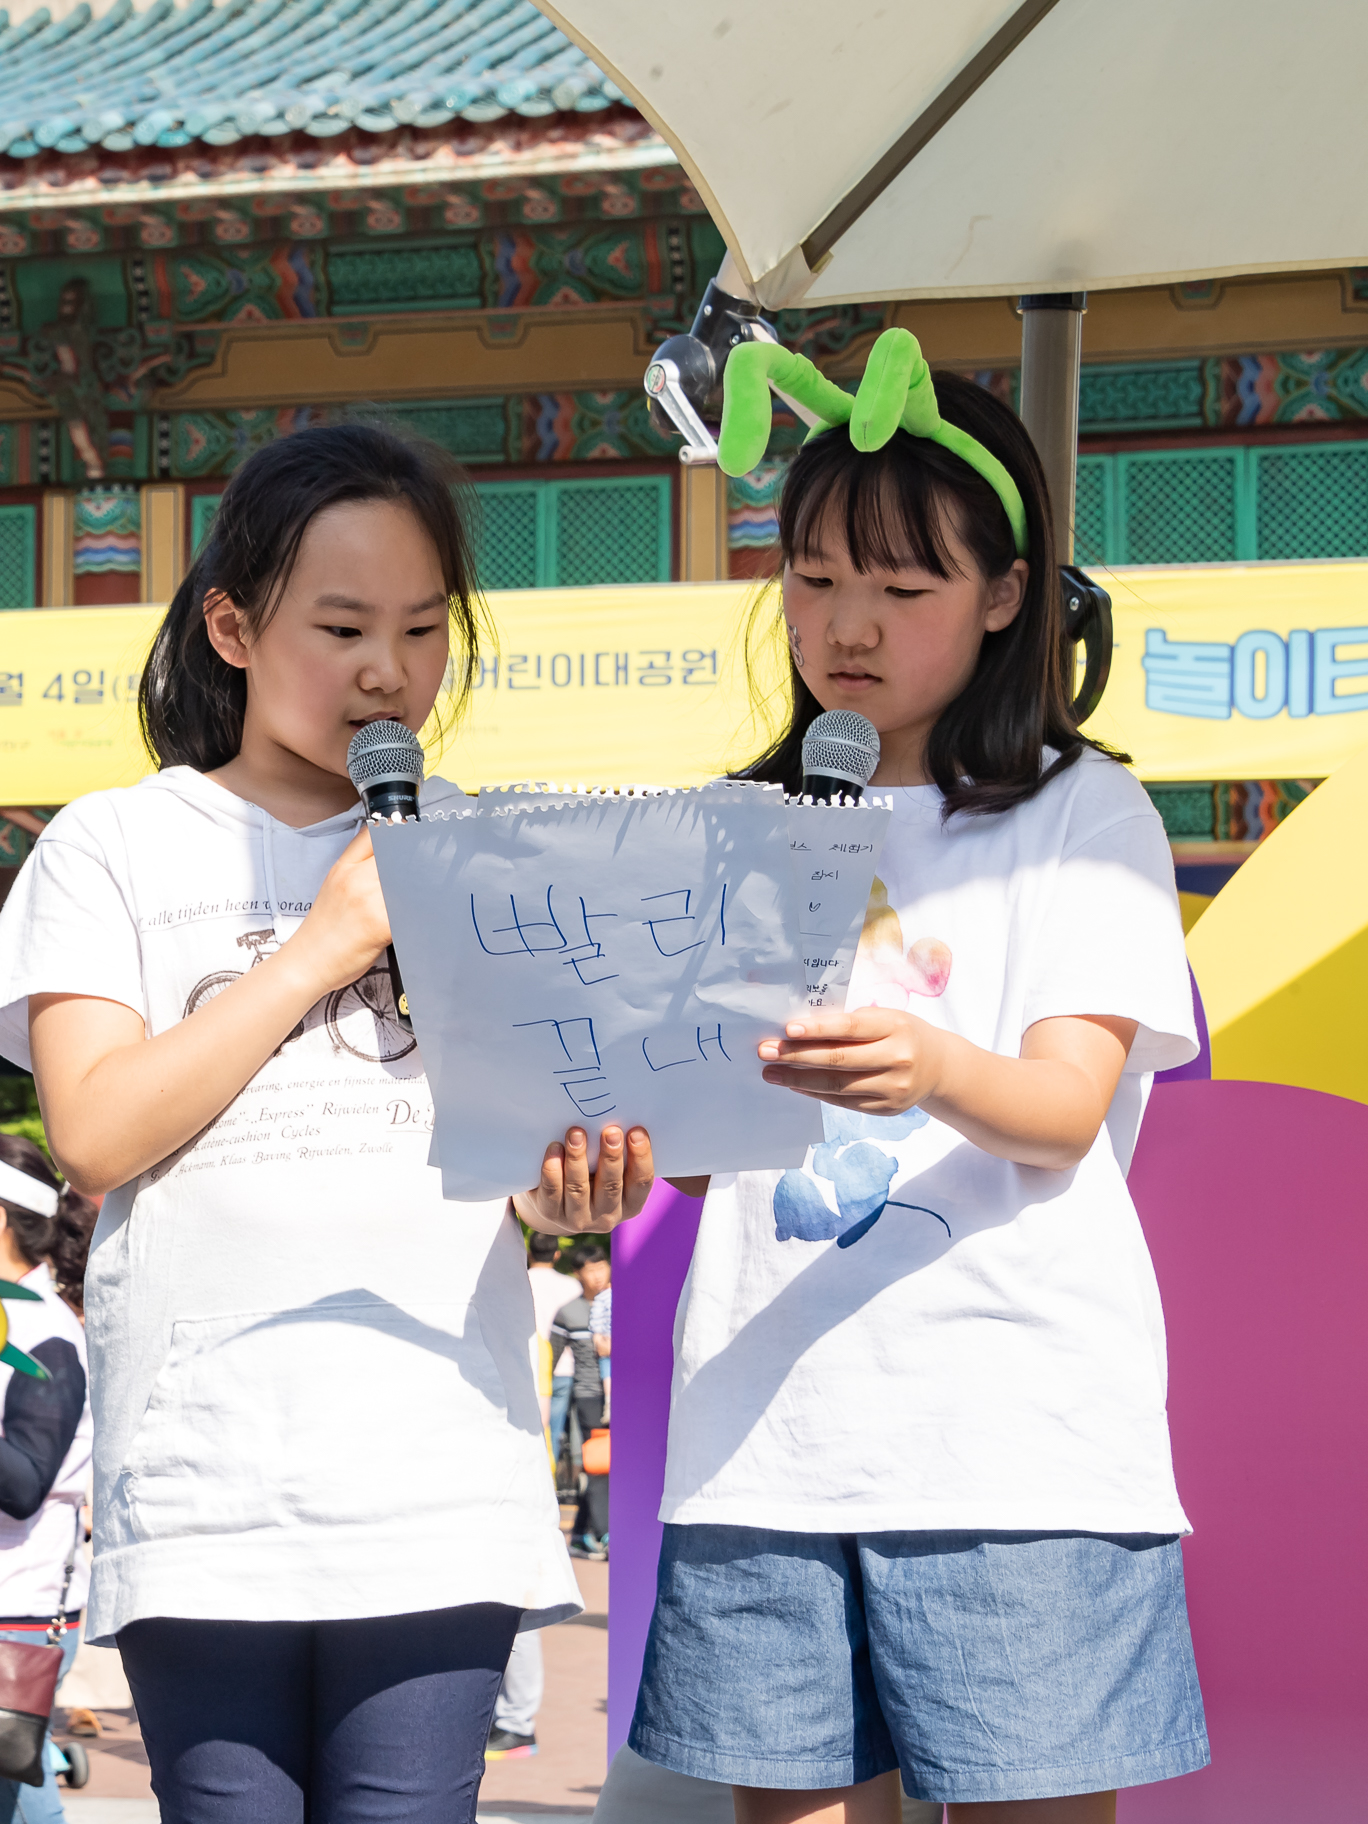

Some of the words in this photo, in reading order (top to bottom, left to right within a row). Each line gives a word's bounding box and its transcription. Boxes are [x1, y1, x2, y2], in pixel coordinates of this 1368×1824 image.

[148, 911, 173, 926] alle
[177, 902, 219, 921] tijden
[225, 899, 259, 912] heen
[287, 1077, 324, 1090] energie
[322, 1101, 379, 1118] Rijwielen
[386, 1099, 420, 1125] De
[281, 1125, 321, 1140] Cycles
